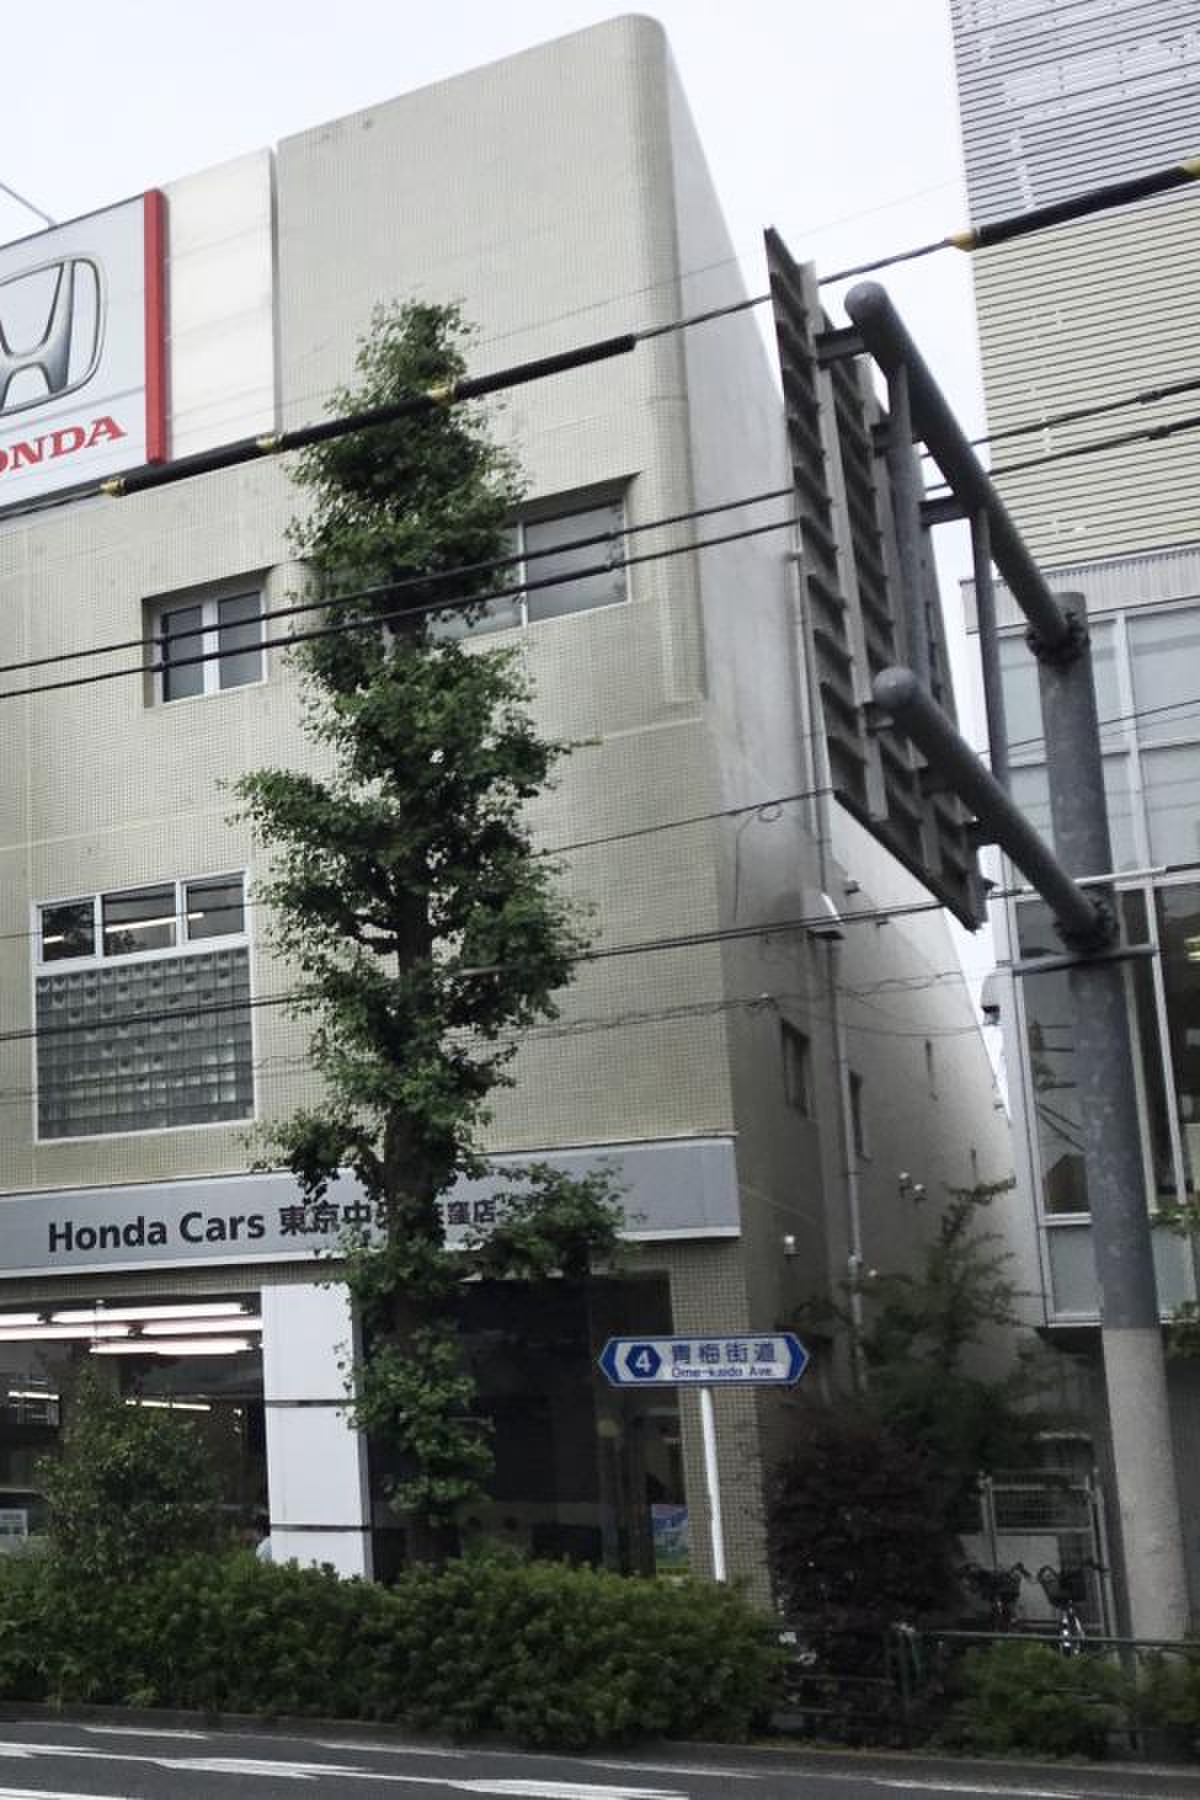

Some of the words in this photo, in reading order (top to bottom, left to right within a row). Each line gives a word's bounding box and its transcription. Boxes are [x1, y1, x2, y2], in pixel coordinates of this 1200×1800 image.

[48, 1216, 168, 1253] Honda
[178, 1211, 266, 1244] Cars
[635, 1350, 651, 1374] 4
[671, 1341, 777, 1364] 青梅街道
